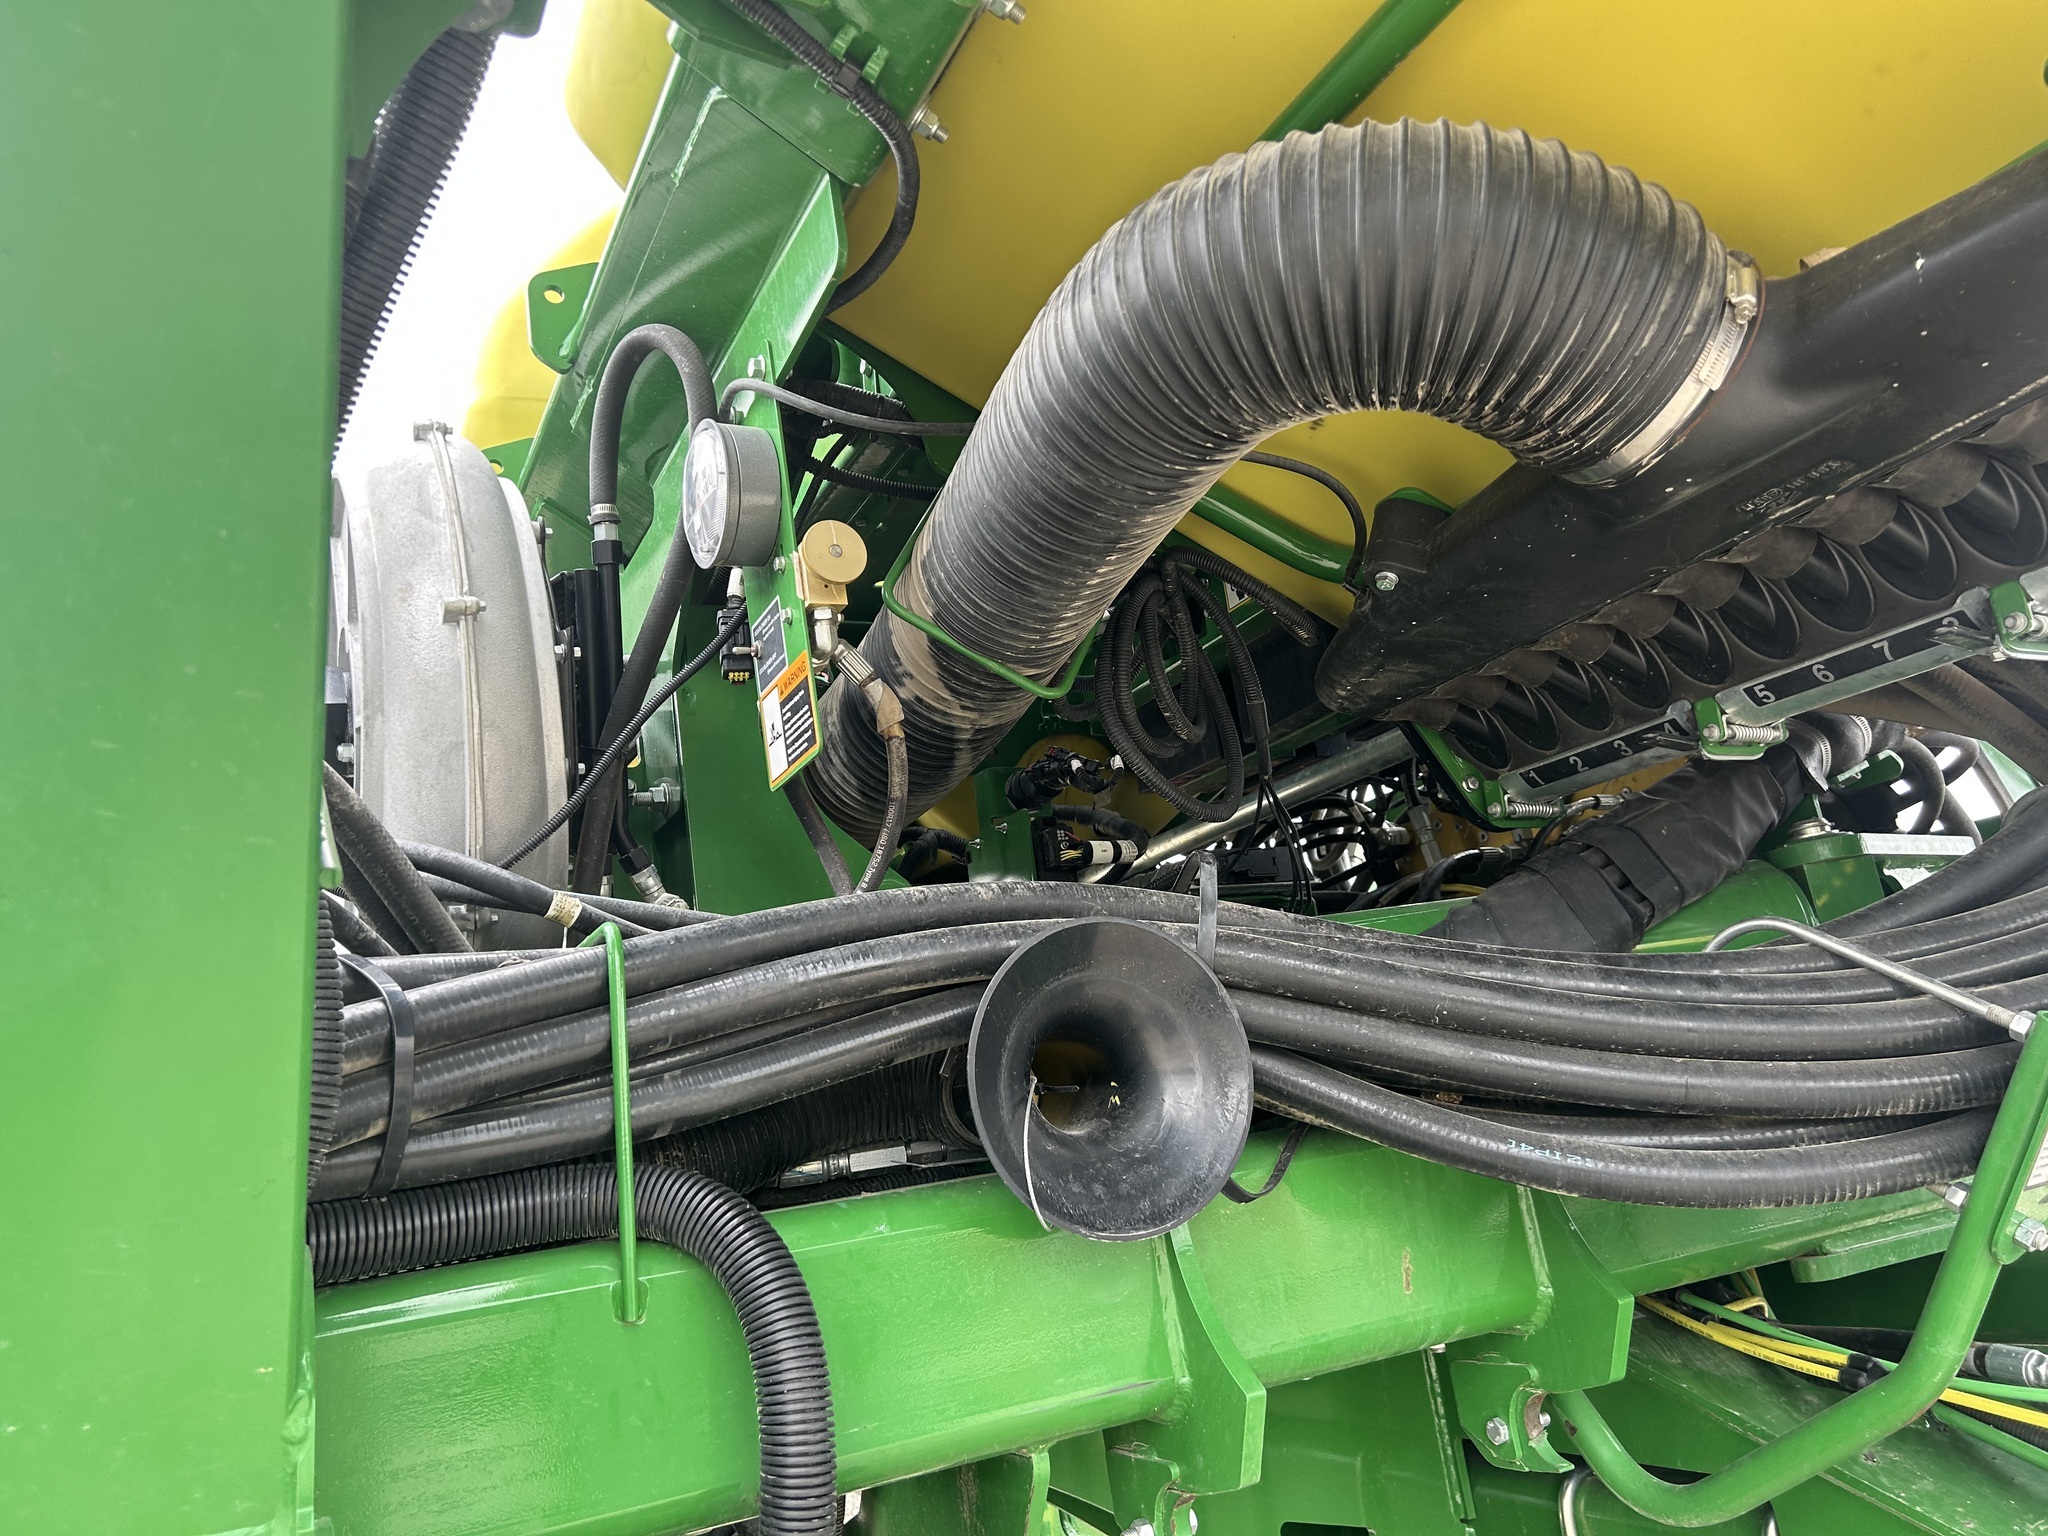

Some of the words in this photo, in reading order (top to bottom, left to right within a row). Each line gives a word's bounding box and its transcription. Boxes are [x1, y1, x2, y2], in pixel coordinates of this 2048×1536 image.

[783, 661, 807, 692] WARNING
[1753, 683, 1776, 704] 5
[1811, 663, 1835, 683] 6
[1871, 640, 1894, 661] 7
[1529, 770, 1545, 785] 1
[1569, 756, 1589, 773] 2
[1613, 739, 1634, 756] 3
